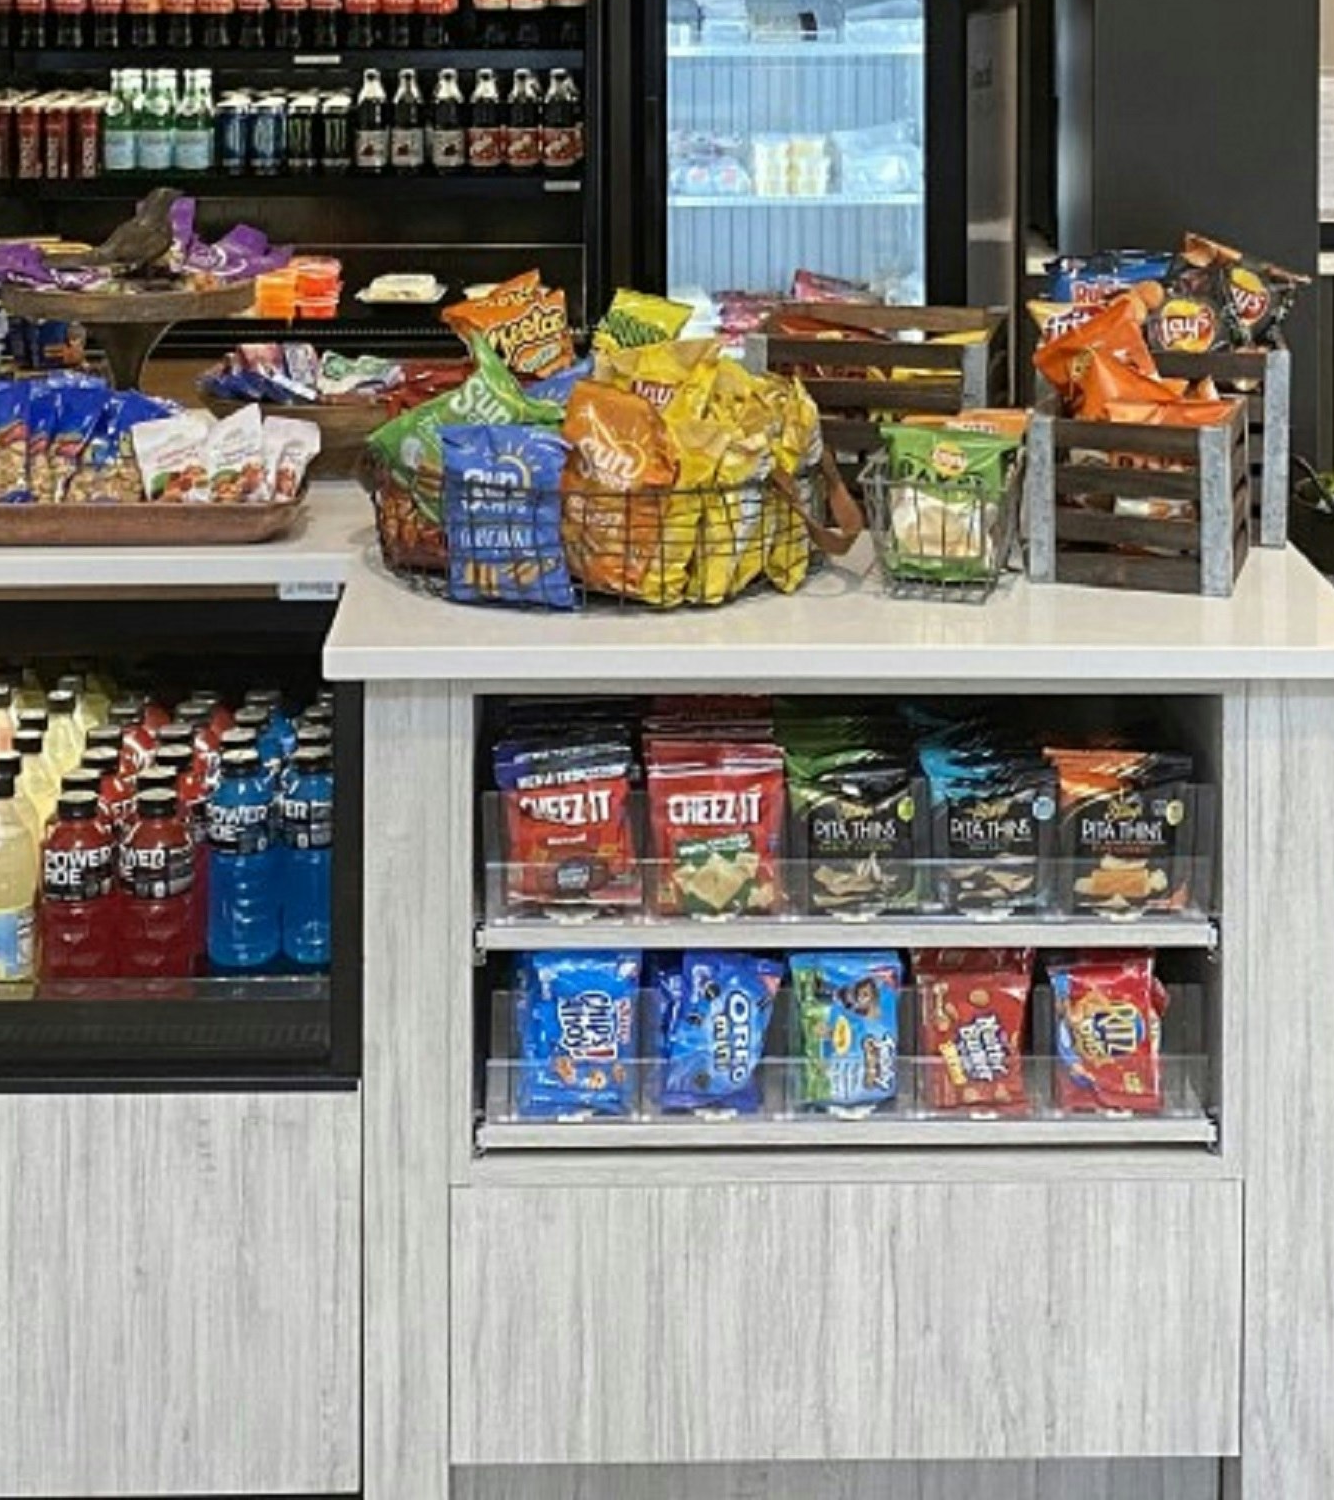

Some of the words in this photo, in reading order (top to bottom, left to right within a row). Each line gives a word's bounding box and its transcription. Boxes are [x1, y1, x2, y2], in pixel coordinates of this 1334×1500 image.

[813, 819, 849, 841] PITA
[850, 819, 897, 841] THINS
[949, 818, 985, 842] PITA
[986, 819, 1032, 841] THINS
[1081, 818, 1116, 842] PITA
[1118, 820, 1164, 842] THINS
[728, 990, 750, 1084] OREO
[1097, 1002, 1137, 1057] RITZ
